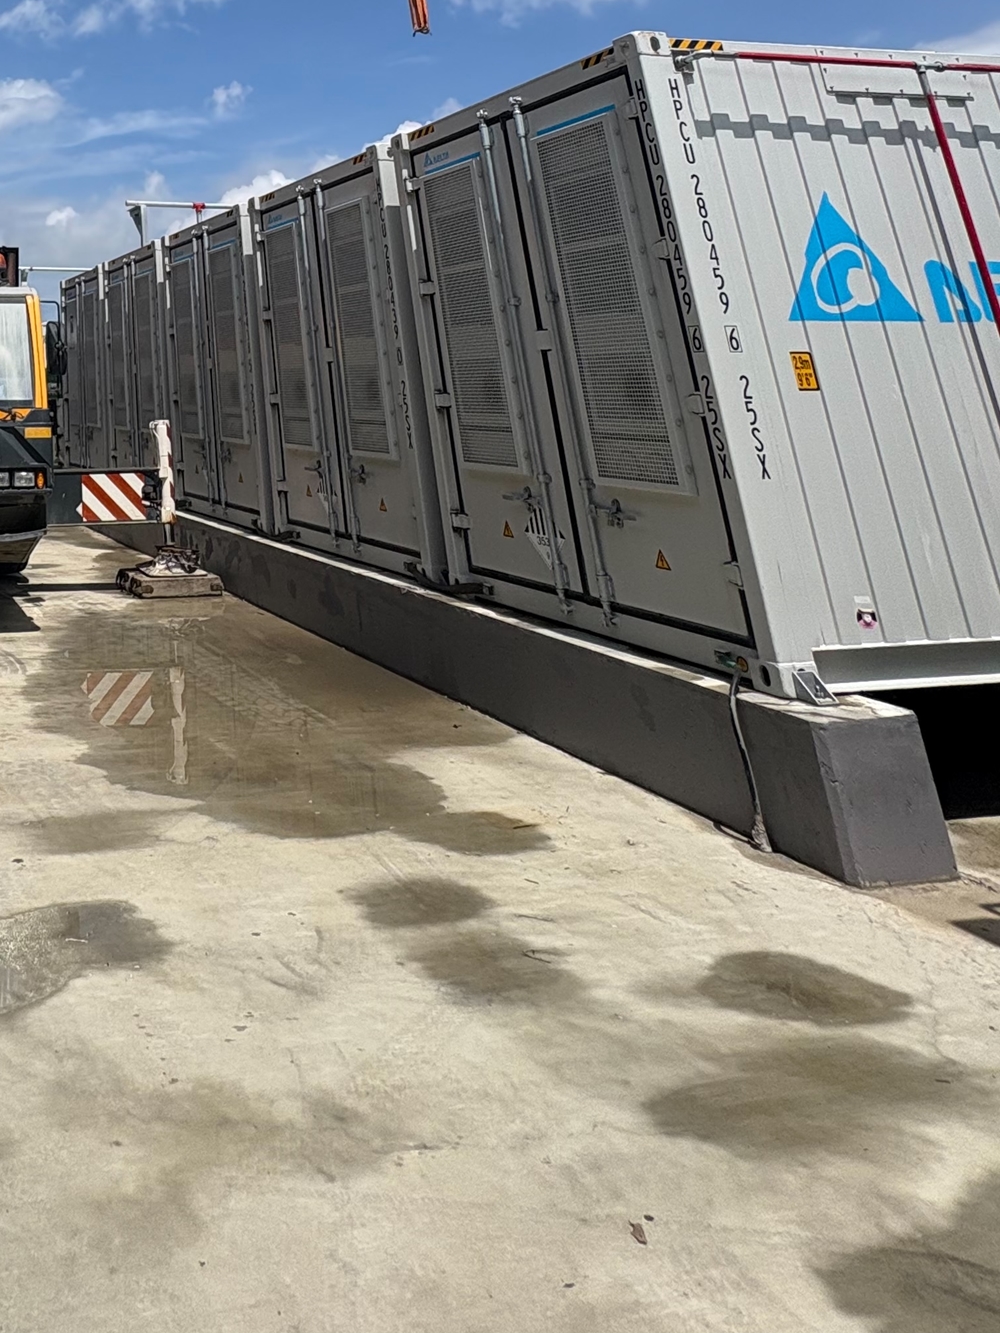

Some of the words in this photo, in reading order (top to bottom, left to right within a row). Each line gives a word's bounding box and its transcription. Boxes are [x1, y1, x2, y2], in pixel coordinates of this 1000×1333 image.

[634, 78, 660, 166] HPCU
[655, 174, 692, 315] 280459
[692, 327, 701, 351] 6
[701, 375, 732, 480] 25SX
[668, 78, 696, 165] HPCU
[690, 174, 730, 315] 280459
[729, 327, 740, 351] 6
[739, 375, 772, 480] 25SX
